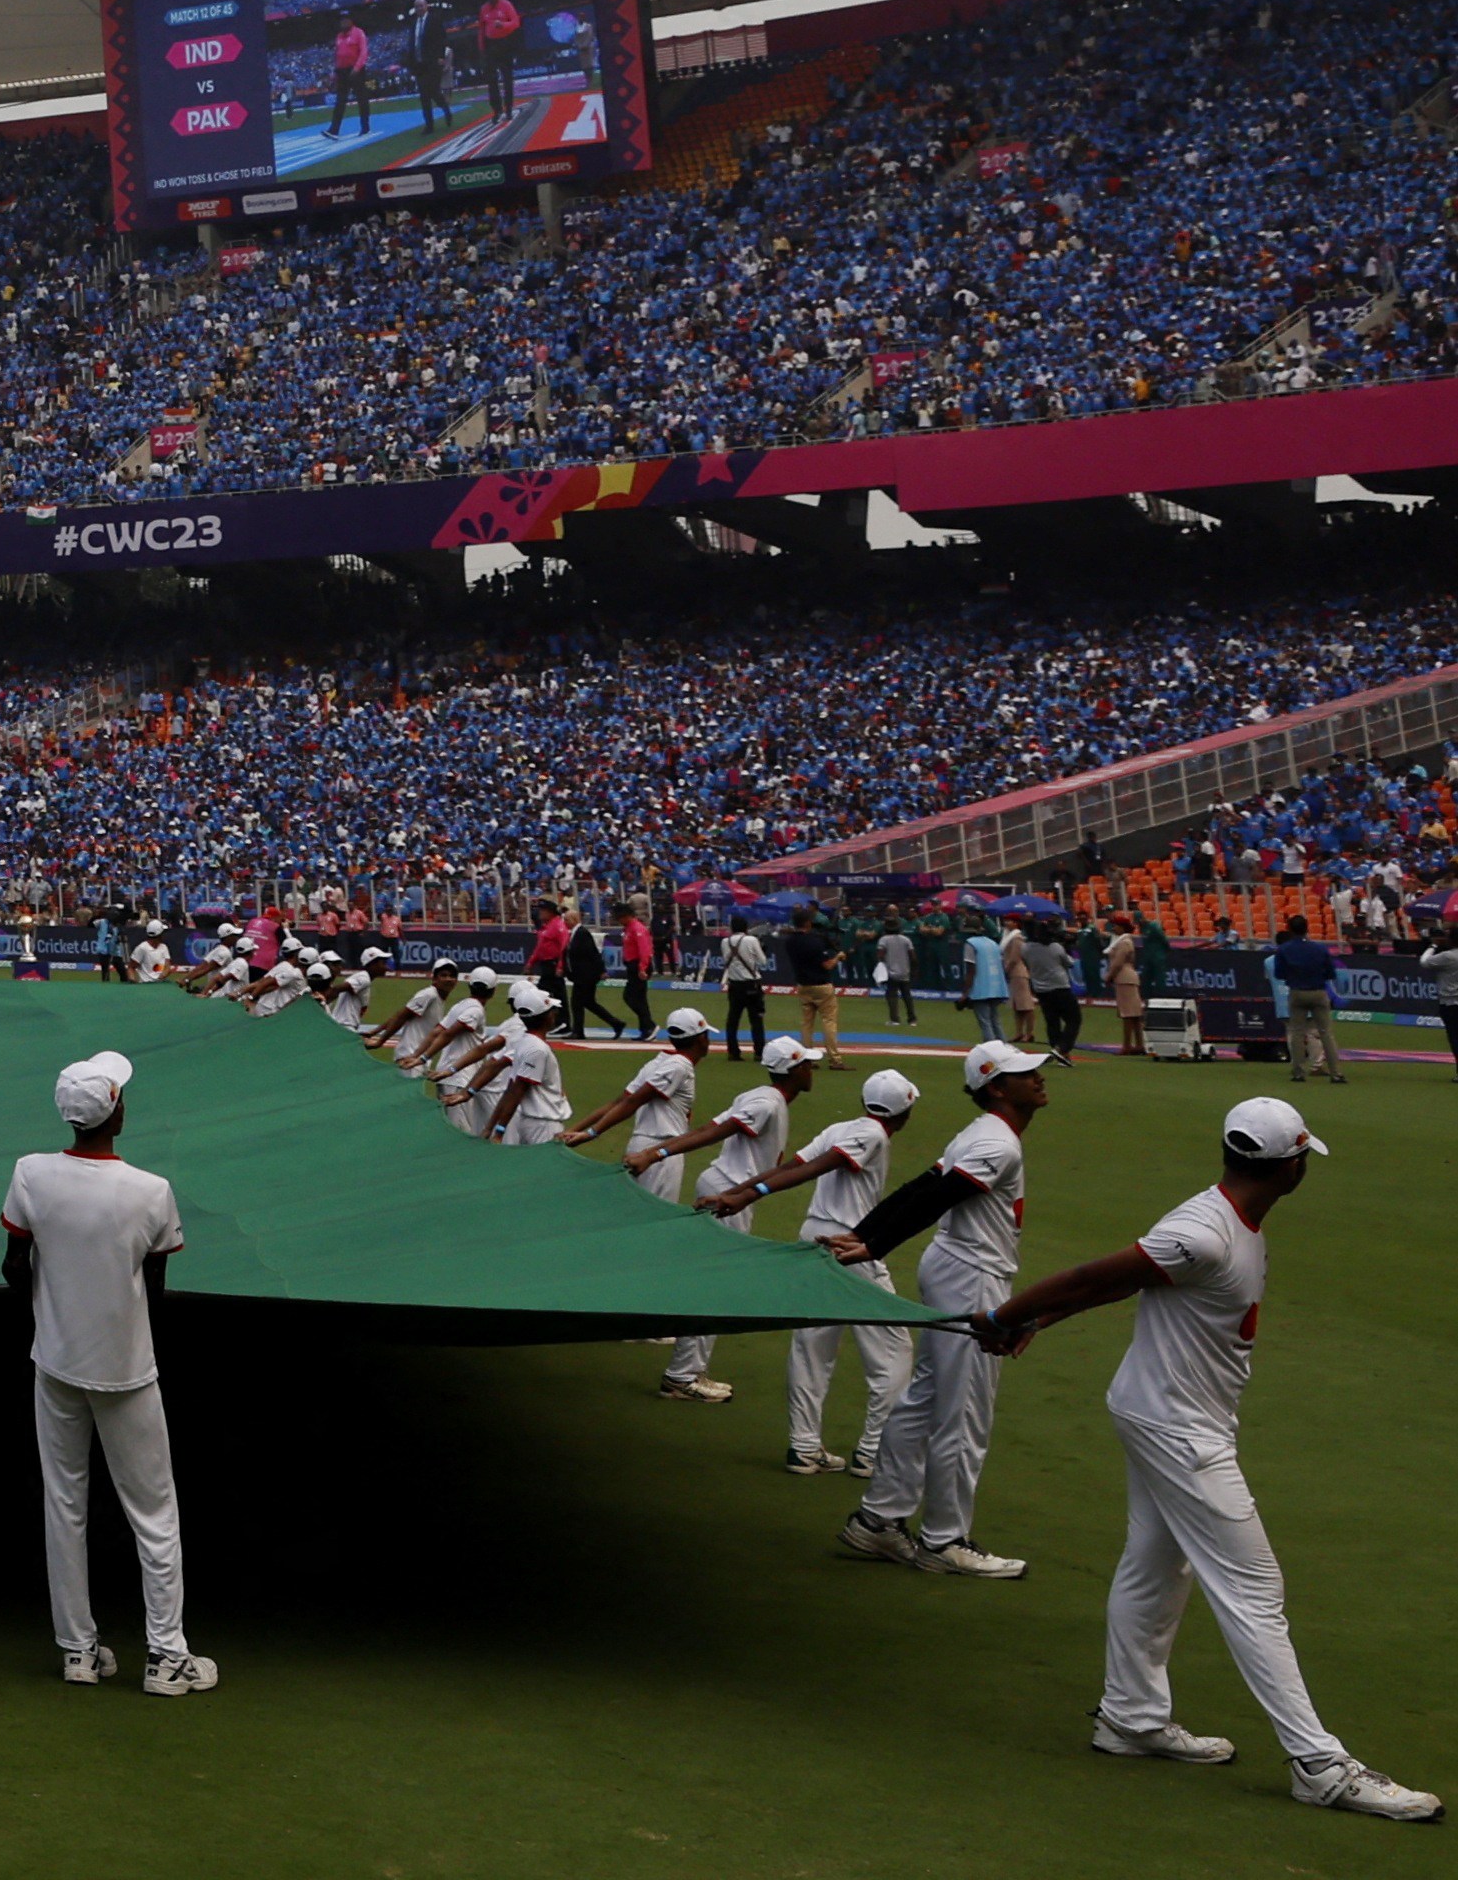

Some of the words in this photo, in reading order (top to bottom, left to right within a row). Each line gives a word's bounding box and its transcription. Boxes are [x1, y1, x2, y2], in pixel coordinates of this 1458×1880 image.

[170, 7, 199, 25] MATCH
[200, 6, 208, 20] 12
[210, 5, 222, 18] OF
[222, 2, 233, 16] 45
[185, 40, 222, 64] IND
[196, 80, 215, 94] VS
[187, 106, 231, 131] PAK
[153, 178, 167, 189] IND
[168, 176, 187, 188] WON
[187, 173, 206, 185] TOSS
[213, 169, 239, 182] CHOSE
[240, 167, 251, 179] TO
[251, 165, 273, 178] FIELD
[448, 169, 501, 186] aramco
[523, 161, 573, 176] Emirates
[246, 197, 294, 208] Booking.com
[331, 194, 355, 204] Bank
[53, 515, 222, 557] #CWC23
[37, 939, 80, 954] Cricket
[433, 945, 479, 962] Cricket
[480, 946, 490, 962] 4
[491, 948, 524, 963] Good
[1194, 969, 1236, 990] Good
[1352, 976, 1383, 996] ICC
[1389, 977, 1437, 1000] Cricke
